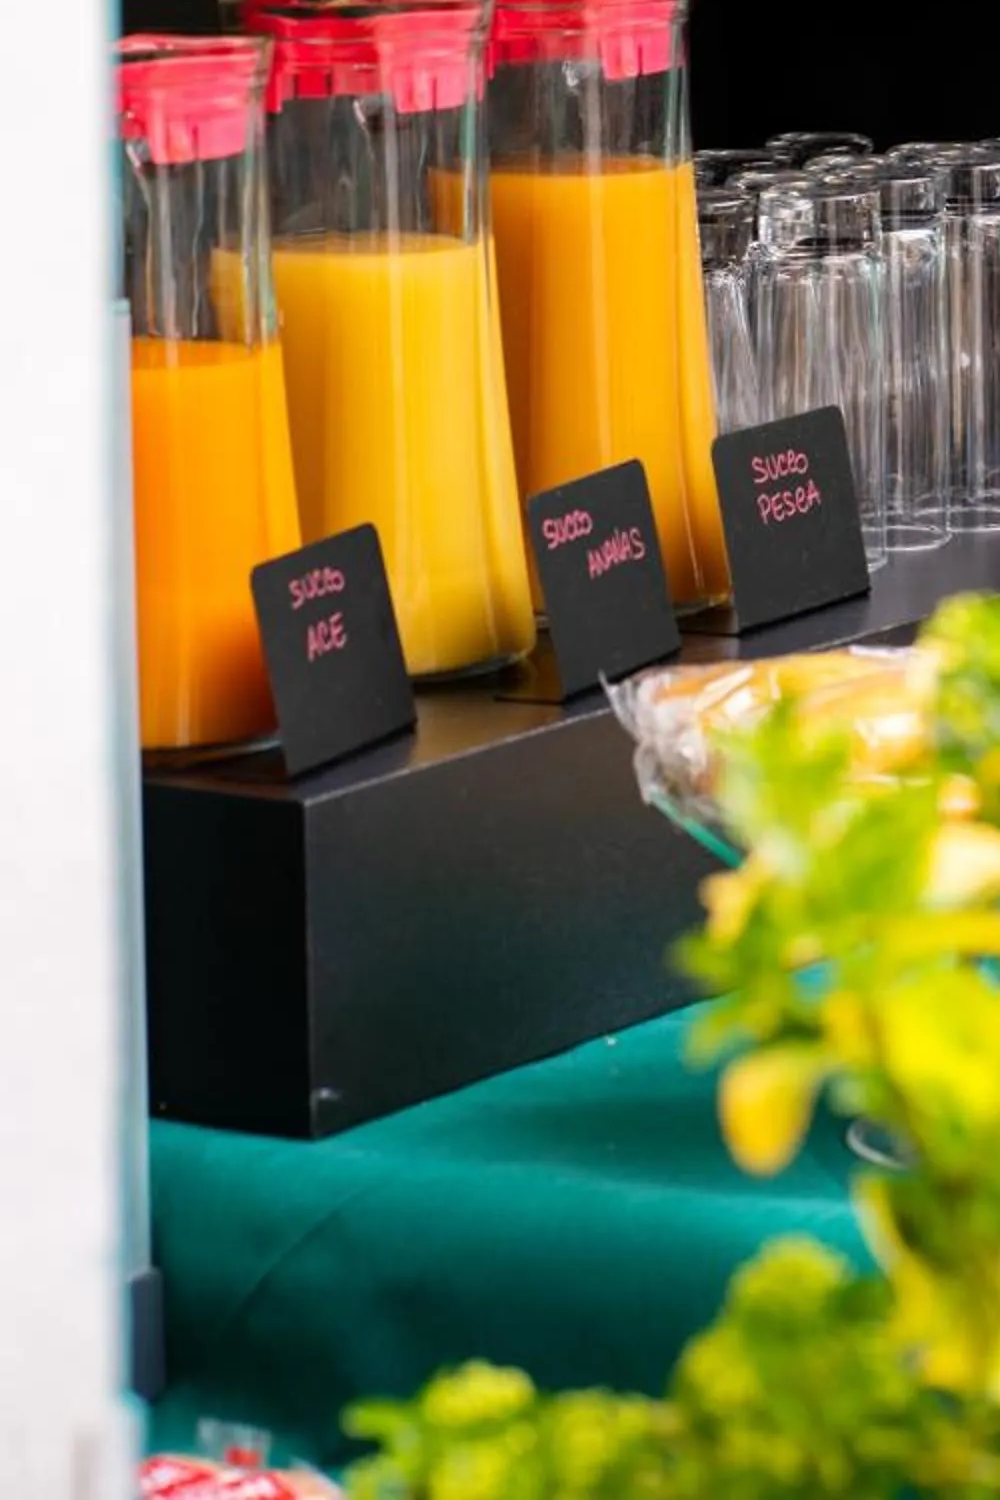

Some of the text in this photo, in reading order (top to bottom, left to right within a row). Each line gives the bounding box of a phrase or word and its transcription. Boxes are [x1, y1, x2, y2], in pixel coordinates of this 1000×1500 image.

[751, 449, 808, 484] SUCCO
[757, 479, 823, 525] PESCA
[542, 510, 594, 551] SUCCO
[586, 526, 647, 580] ANANAS
[288, 566, 346, 610] SUCCO
[306, 611, 348, 662] ACE
